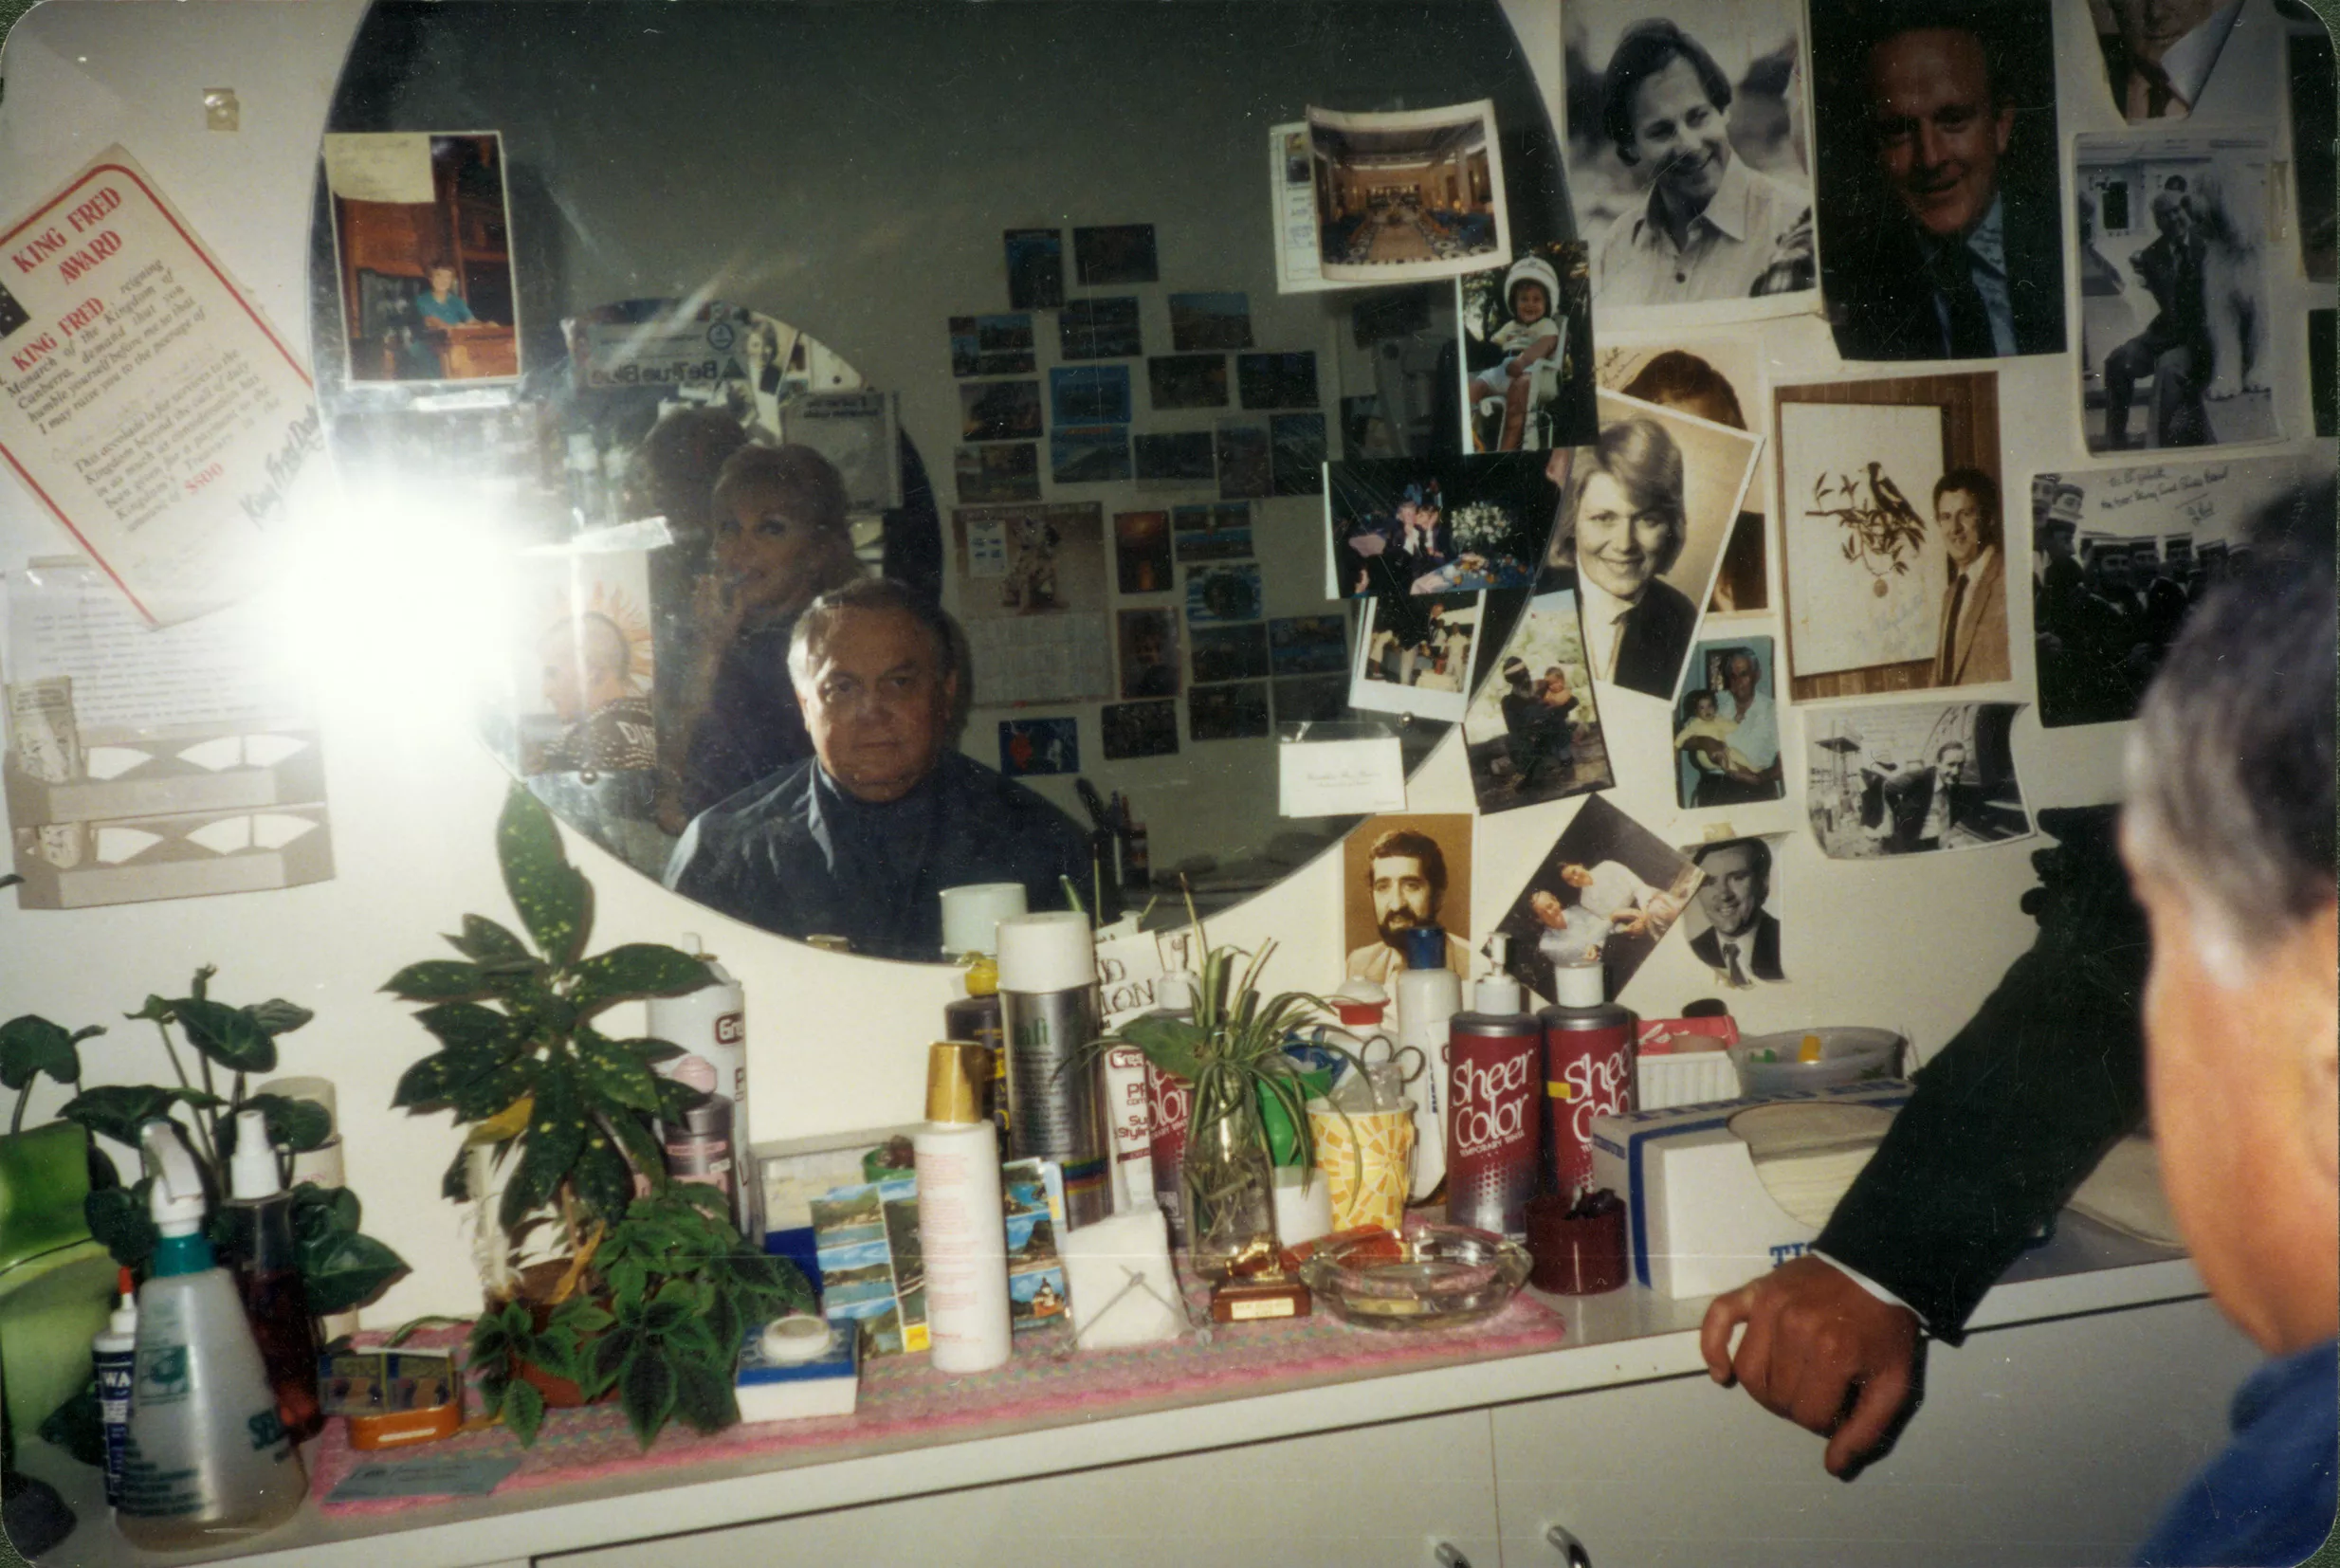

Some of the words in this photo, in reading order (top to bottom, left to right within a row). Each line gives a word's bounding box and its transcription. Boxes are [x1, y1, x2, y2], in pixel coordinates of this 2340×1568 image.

[11, 228, 67, 273] KING
[67, 187, 121, 233] FRED
[59, 230, 122, 285] AWARD
[7, 356, 58, 398] Monarch
[81, 326, 100, 343] the
[103, 285, 156, 326] Kingdom
[11, 332, 58, 372] KING
[58, 298, 104, 337] FRED
[120, 259, 164, 294] reigning
[82, 325, 125, 364] demand
[27, 390, 68, 423] humble
[68, 356, 110, 396] yourself
[1453, 1048, 1535, 1107] Sheer
[1455, 1093, 1530, 1148] Color
[1459, 1140, 1503, 1158] TEMPORARY
[1506, 1129, 1526, 1143] RINSE
